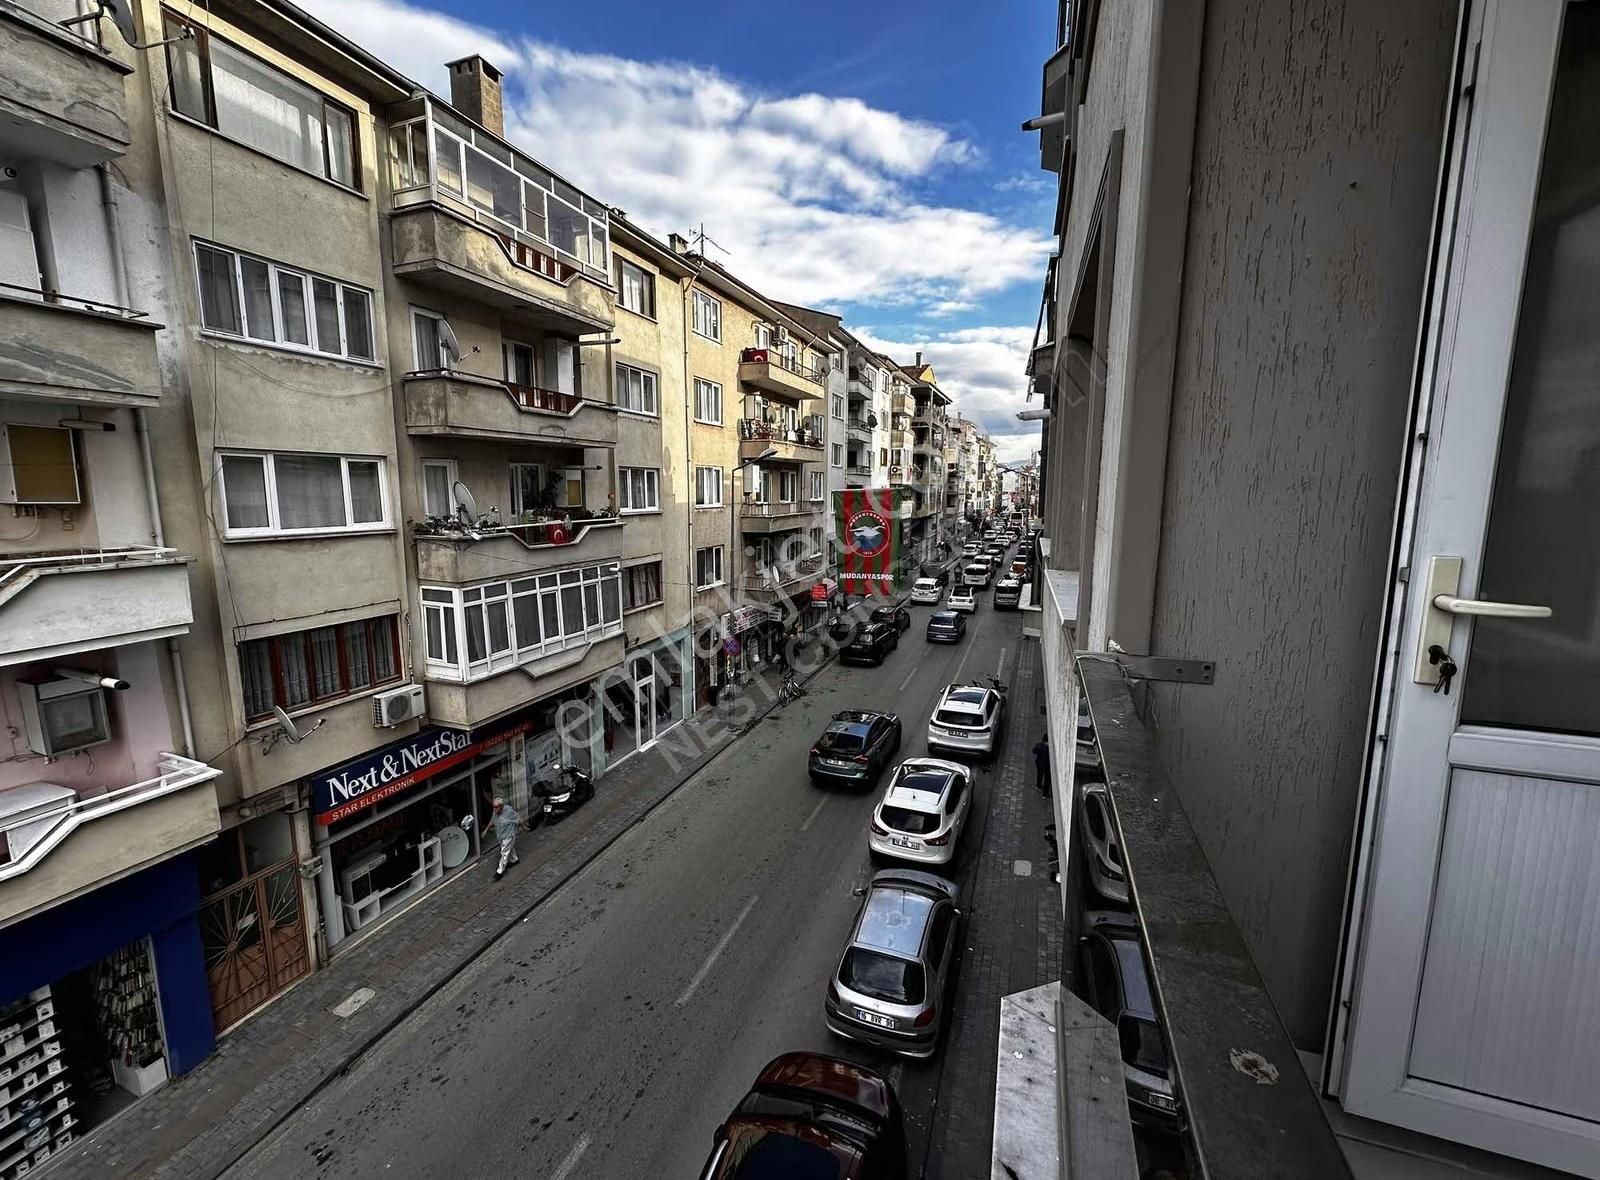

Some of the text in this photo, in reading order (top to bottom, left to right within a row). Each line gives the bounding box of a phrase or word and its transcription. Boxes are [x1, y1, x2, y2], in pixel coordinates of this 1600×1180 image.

[839, 572, 894, 581] MUDANYASPOR
[326, 766, 379, 806] Next
[380, 755, 402, 783] &
[331, 802, 358, 821] STAR
